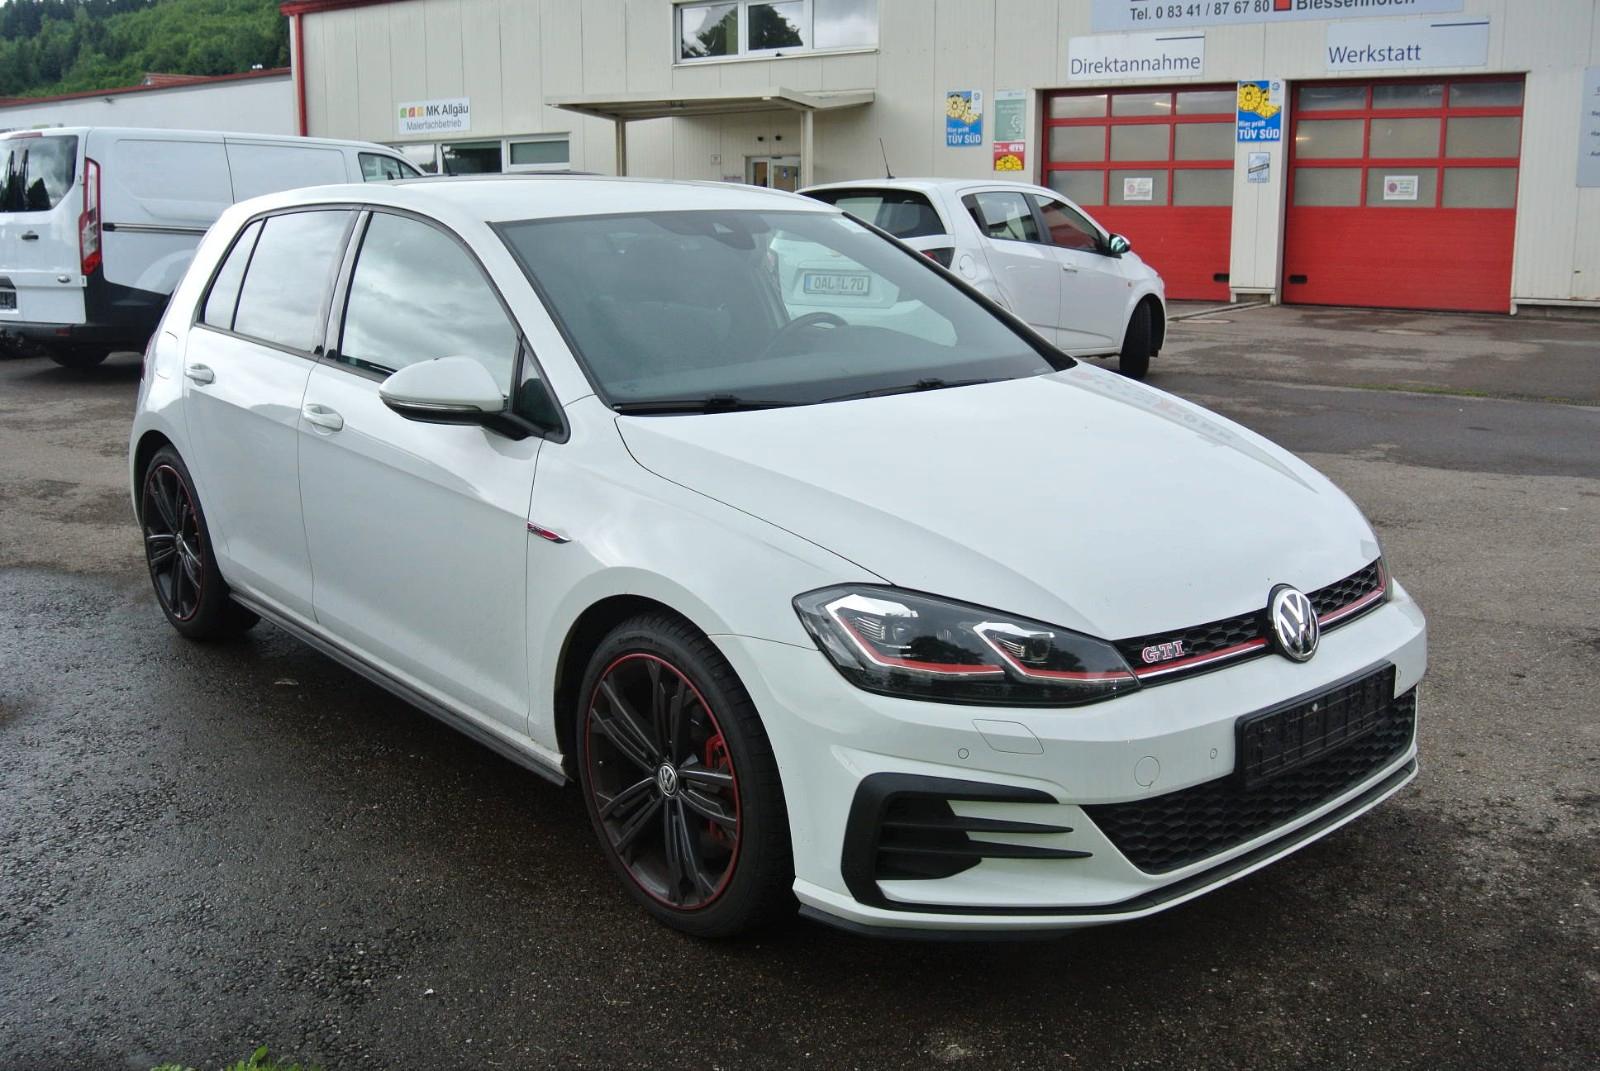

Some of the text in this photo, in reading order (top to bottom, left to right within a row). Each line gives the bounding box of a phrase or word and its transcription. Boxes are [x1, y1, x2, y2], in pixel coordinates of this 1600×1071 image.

[1130, 8, 1151, 20] Tel.
[1156, 6, 1163, 19] 0
[1167, 5, 1182, 18] 83
[1186, 4, 1200, 17] 41
[1214, 2, 1229, 15] 87
[1234, 1, 1249, 14] 67
[1254, 0, 1269, 13] 80
[1328, 44, 1422, 63] Werkstatt
[1071, 53, 1200, 75] Direktannahme
[426, 105, 440, 117] MK
[442, 103, 469, 117] Allgäu
[1239, 127, 1280, 140] TÜV SÜD
[1142, 640, 1185, 664] GTI
